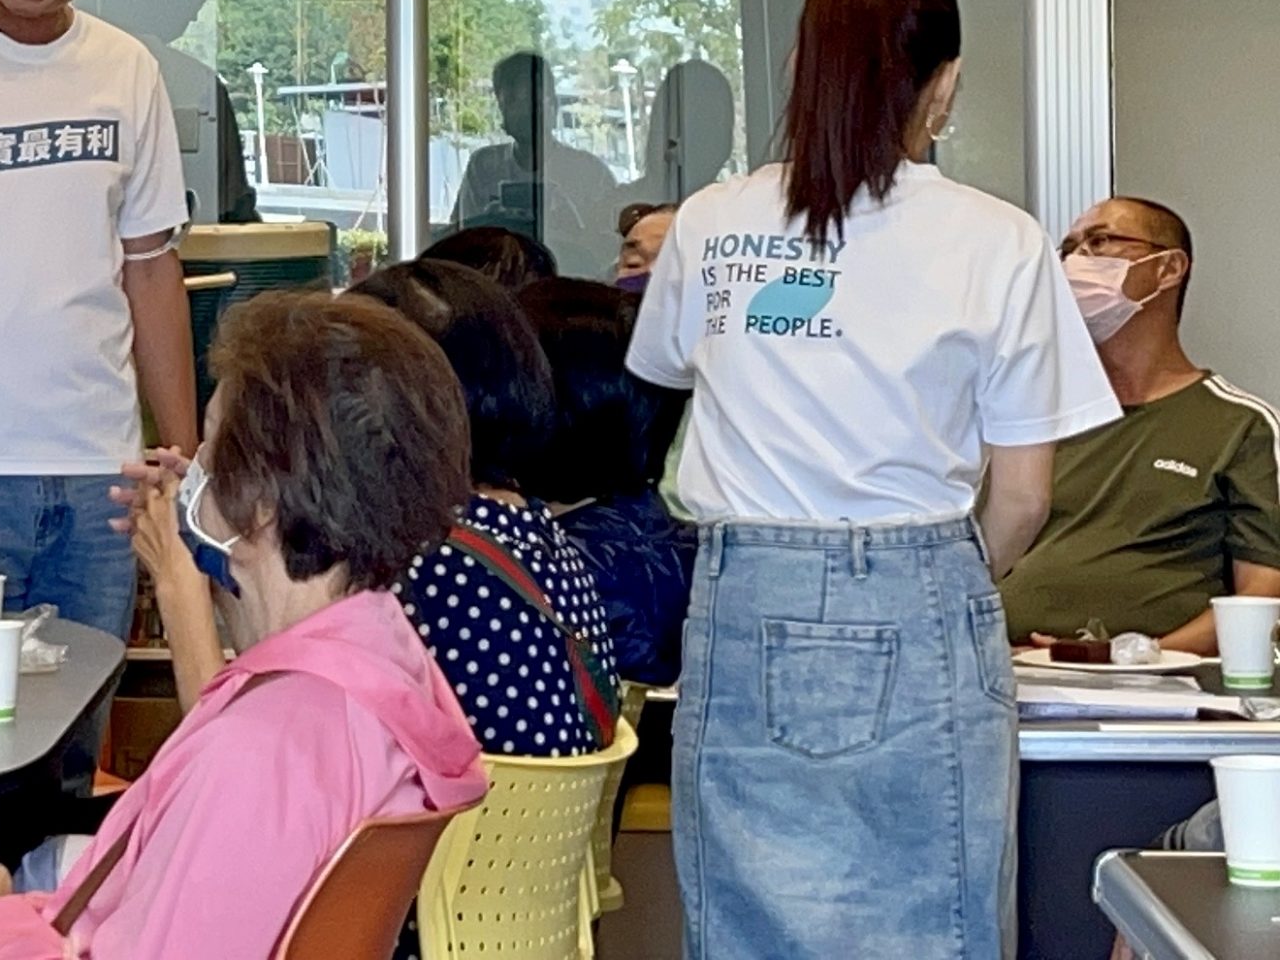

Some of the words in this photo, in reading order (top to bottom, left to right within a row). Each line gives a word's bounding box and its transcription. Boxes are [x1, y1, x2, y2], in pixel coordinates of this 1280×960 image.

[702, 234, 846, 264] HONESTY
[702, 266, 717, 287] IS
[726, 263, 768, 283] THE
[783, 266, 842, 289] BEST
[706, 289, 732, 312] FOR
[705, 315, 727, 337] THE
[745, 314, 843, 339] PEOPLE.
[1153, 458, 1198, 478] adidas
